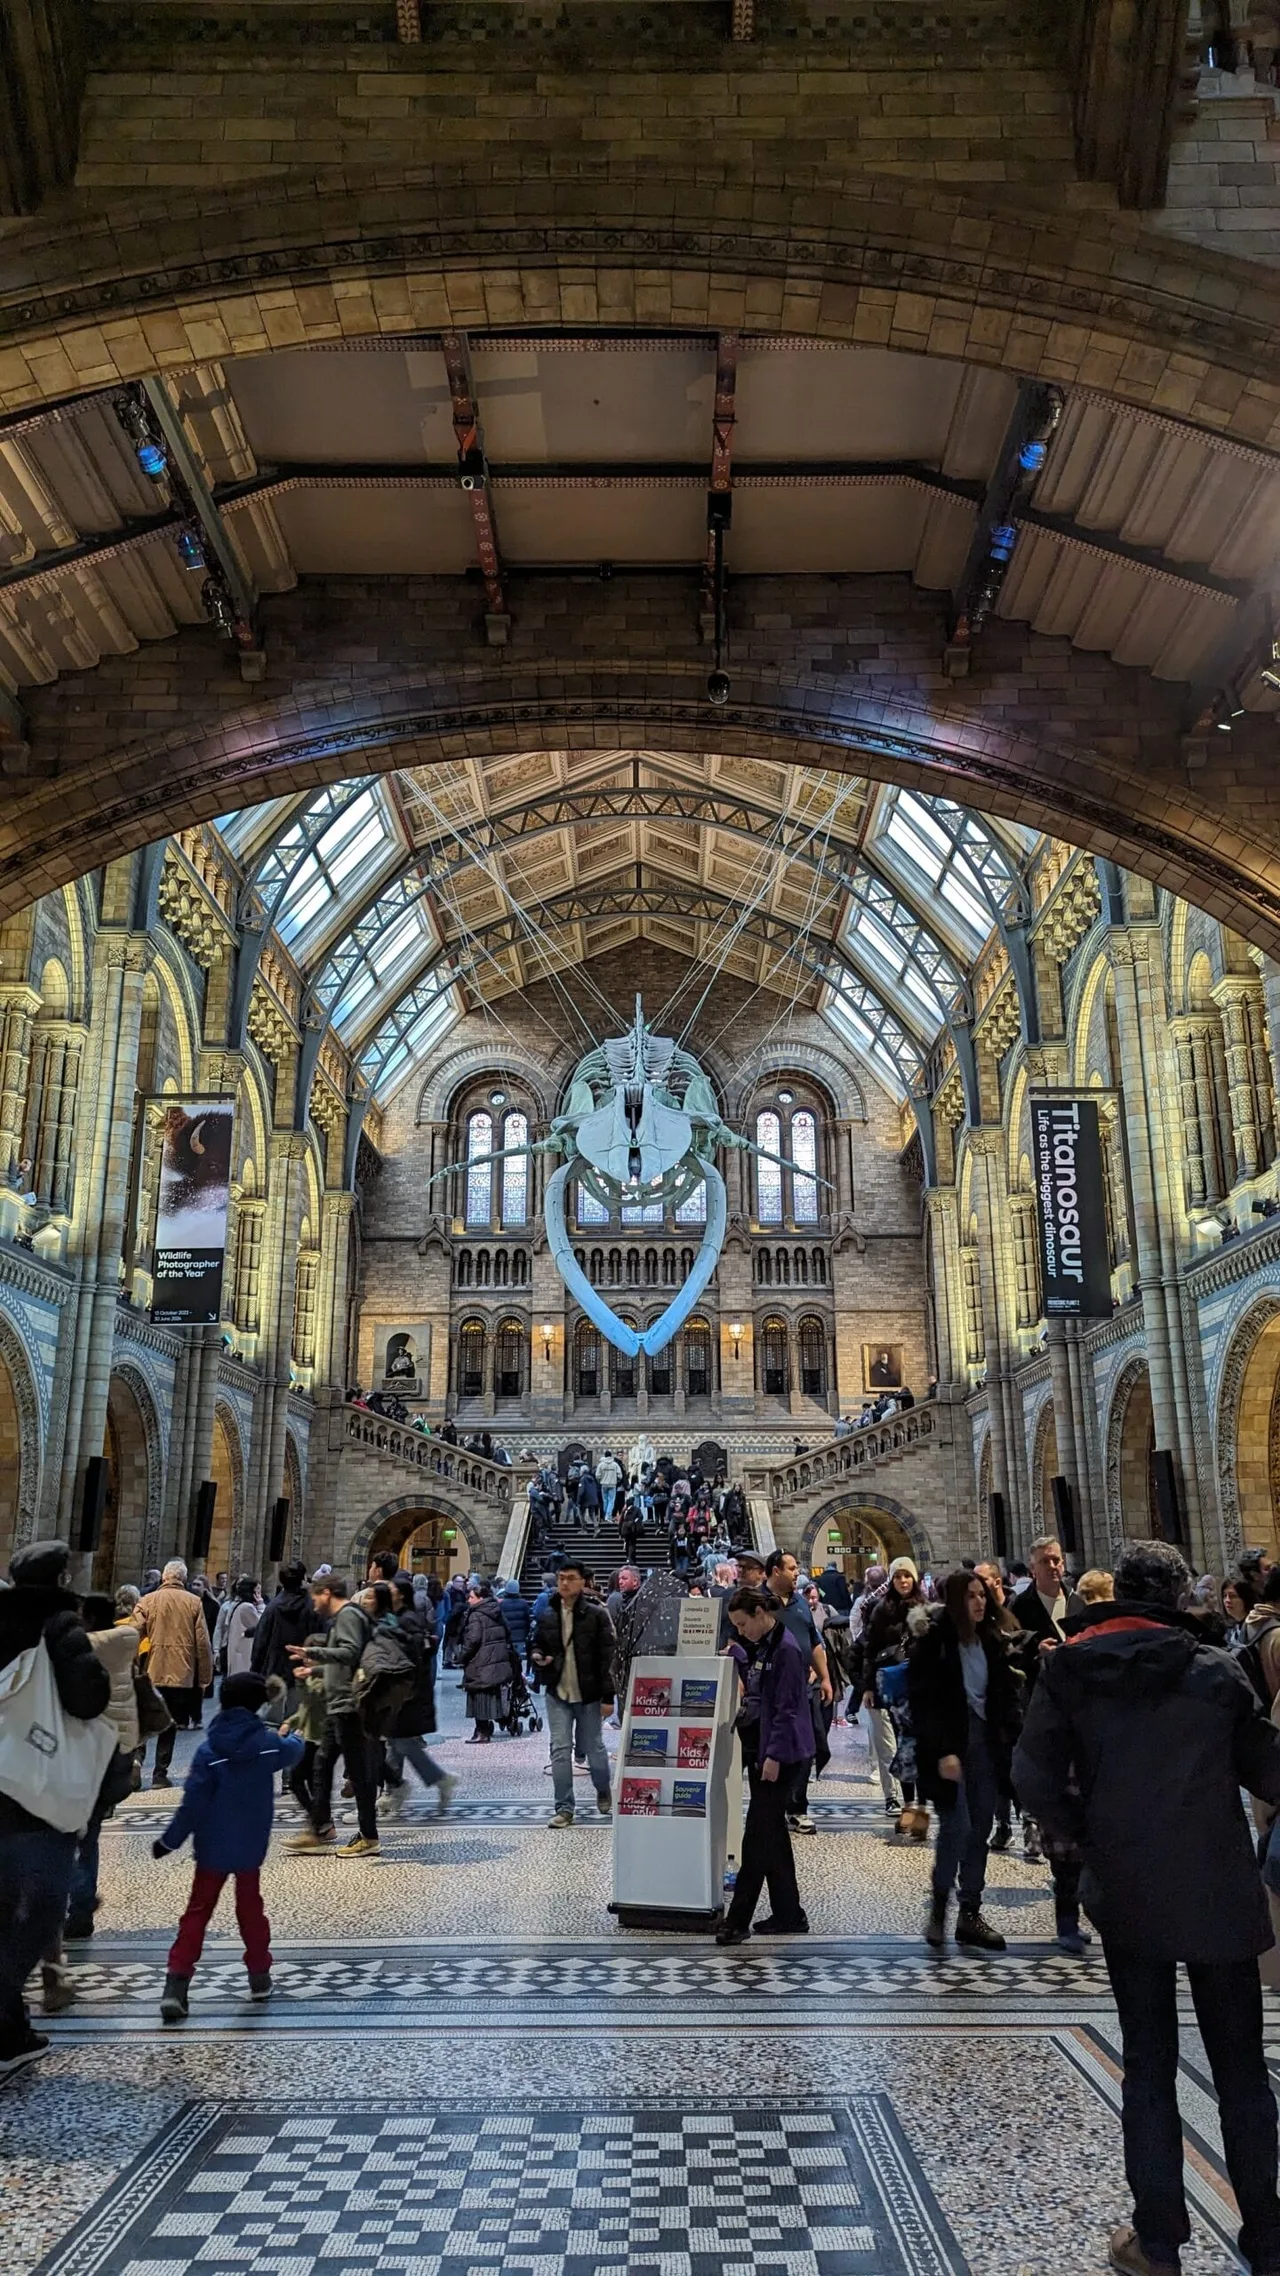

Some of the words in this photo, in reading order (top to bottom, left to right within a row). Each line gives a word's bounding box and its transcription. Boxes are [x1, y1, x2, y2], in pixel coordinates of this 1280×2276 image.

[1037, 1109, 1050, 1132] Life
[1039, 1134, 1048, 1148] as
[1040, 1150, 1052, 1171] the
[1040, 1173, 1054, 1220] biggest
[1051, 1103, 1084, 1284] Titanosaur
[158, 1251, 192, 1260] Wildlife
[1044, 1222, 1057, 1278] dinosaur
[158, 1260, 220, 1270] Photographer
[156, 1269, 168, 1278] of
[168, 1269, 183, 1278] the
[184, 1269, 205, 1277] Year
[685, 1683, 711, 1691] Souvenir
[635, 1695, 658, 1706] Kids
[644, 1707, 668, 1718] only
[633, 1732, 659, 1740] Souvenir
[680, 1746, 702, 1758] Kids
[675, 1785, 701, 1793] Souvenir
[674, 1792, 692, 1800] guide
[623, 1797, 646, 1809] Kids
[632, 1807, 656, 1817] only
